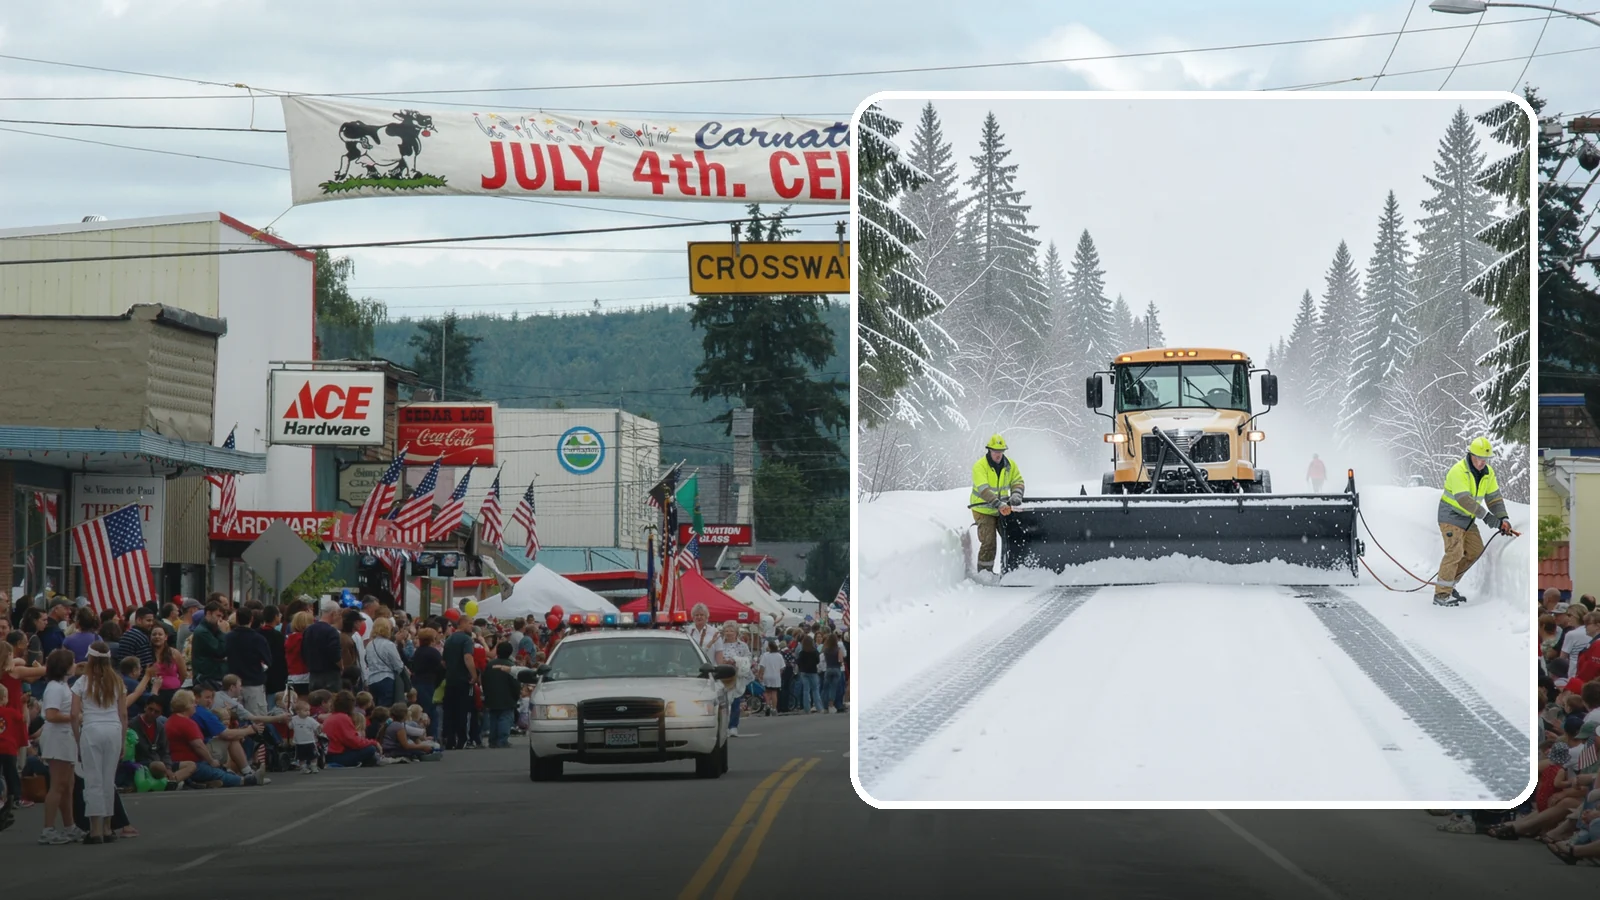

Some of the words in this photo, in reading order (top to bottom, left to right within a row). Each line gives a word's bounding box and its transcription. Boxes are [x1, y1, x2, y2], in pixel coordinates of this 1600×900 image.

[481, 141, 605, 192] JULY
[632, 150, 746, 198] 4th.
[697, 254, 850, 279] CROSSWA
[283, 380, 373, 419] ACE
[406, 409, 452, 422] CEDAR
[283, 421, 370, 436] Hardware
[416, 428, 476, 446] Coca-Cola
[353, 467, 385, 480] Simpl
[83, 485, 93, 494] St.
[96, 485, 124, 494] Vincent
[126, 486, 135, 494] de
[137, 486, 155, 495] Paul
[81, 503, 154, 522] THT
[212, 516, 331, 536] HARDARE
[688, 526, 741, 535] CRNATION
[699, 535, 730, 543] GLASS
